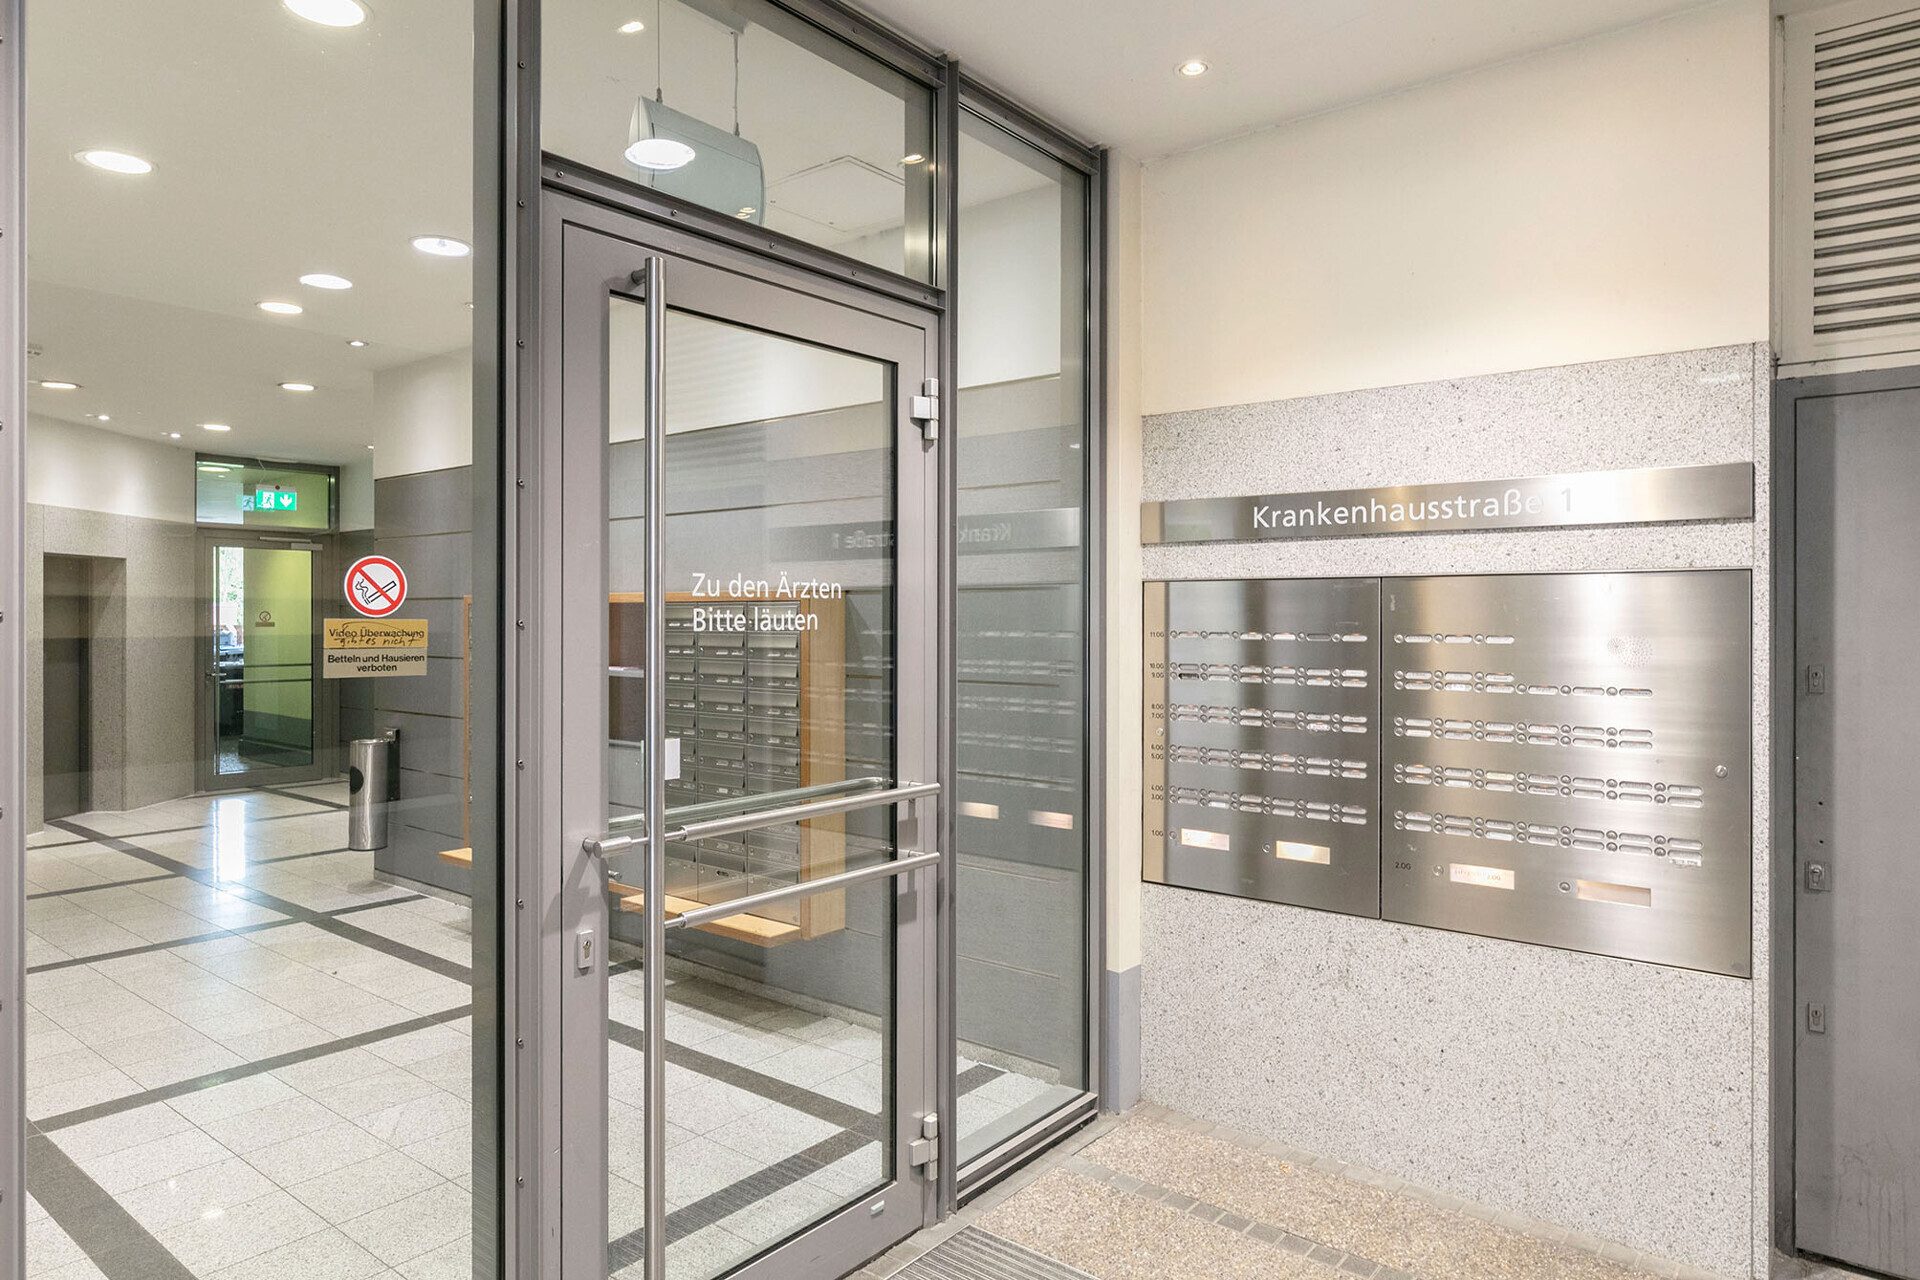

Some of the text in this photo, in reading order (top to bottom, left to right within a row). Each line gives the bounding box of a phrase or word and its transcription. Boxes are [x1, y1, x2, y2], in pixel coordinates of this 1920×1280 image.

[1252, 488, 1571, 529] Krankenhausstraße 1
[692, 571, 842, 599] Zu den Ärzten
[693, 606, 818, 632] Bitte läuten
[329, 626, 425, 638] Video Überwachung
[328, 653, 425, 663] Betteln und Hausieren
[356, 664, 398, 672] verboten
